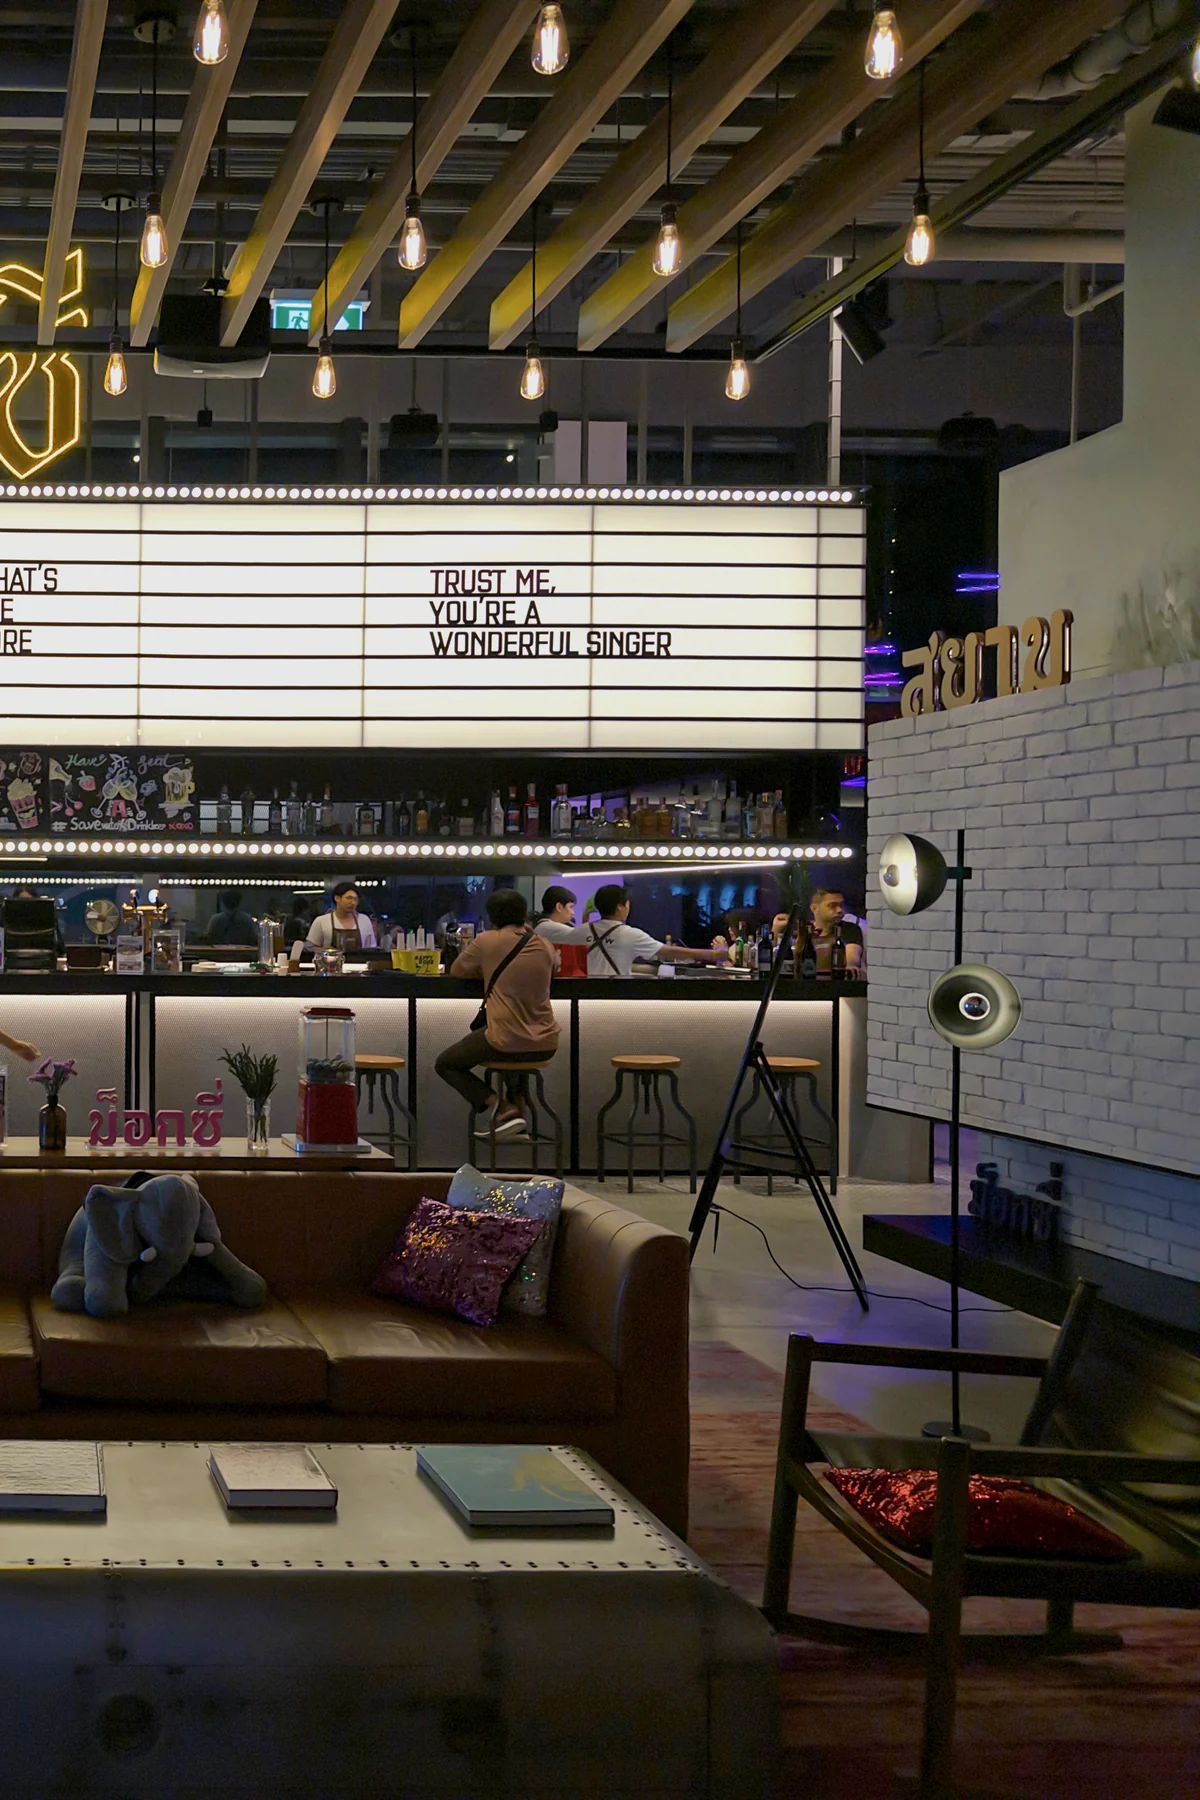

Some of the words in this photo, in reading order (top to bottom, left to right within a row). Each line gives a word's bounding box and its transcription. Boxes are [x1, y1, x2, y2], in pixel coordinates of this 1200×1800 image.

[430, 569, 507, 594] TRUST
[515, 569, 557, 595] ME,
[429, 595, 516, 625] YOU'RE
[524, 600, 542, 625] A
[429, 631, 579, 656] WONDERFUL
[586, 631, 673, 656] SINGER
[900, 608, 1074, 717] สยาม
[586, 935, 615, 945] CW
